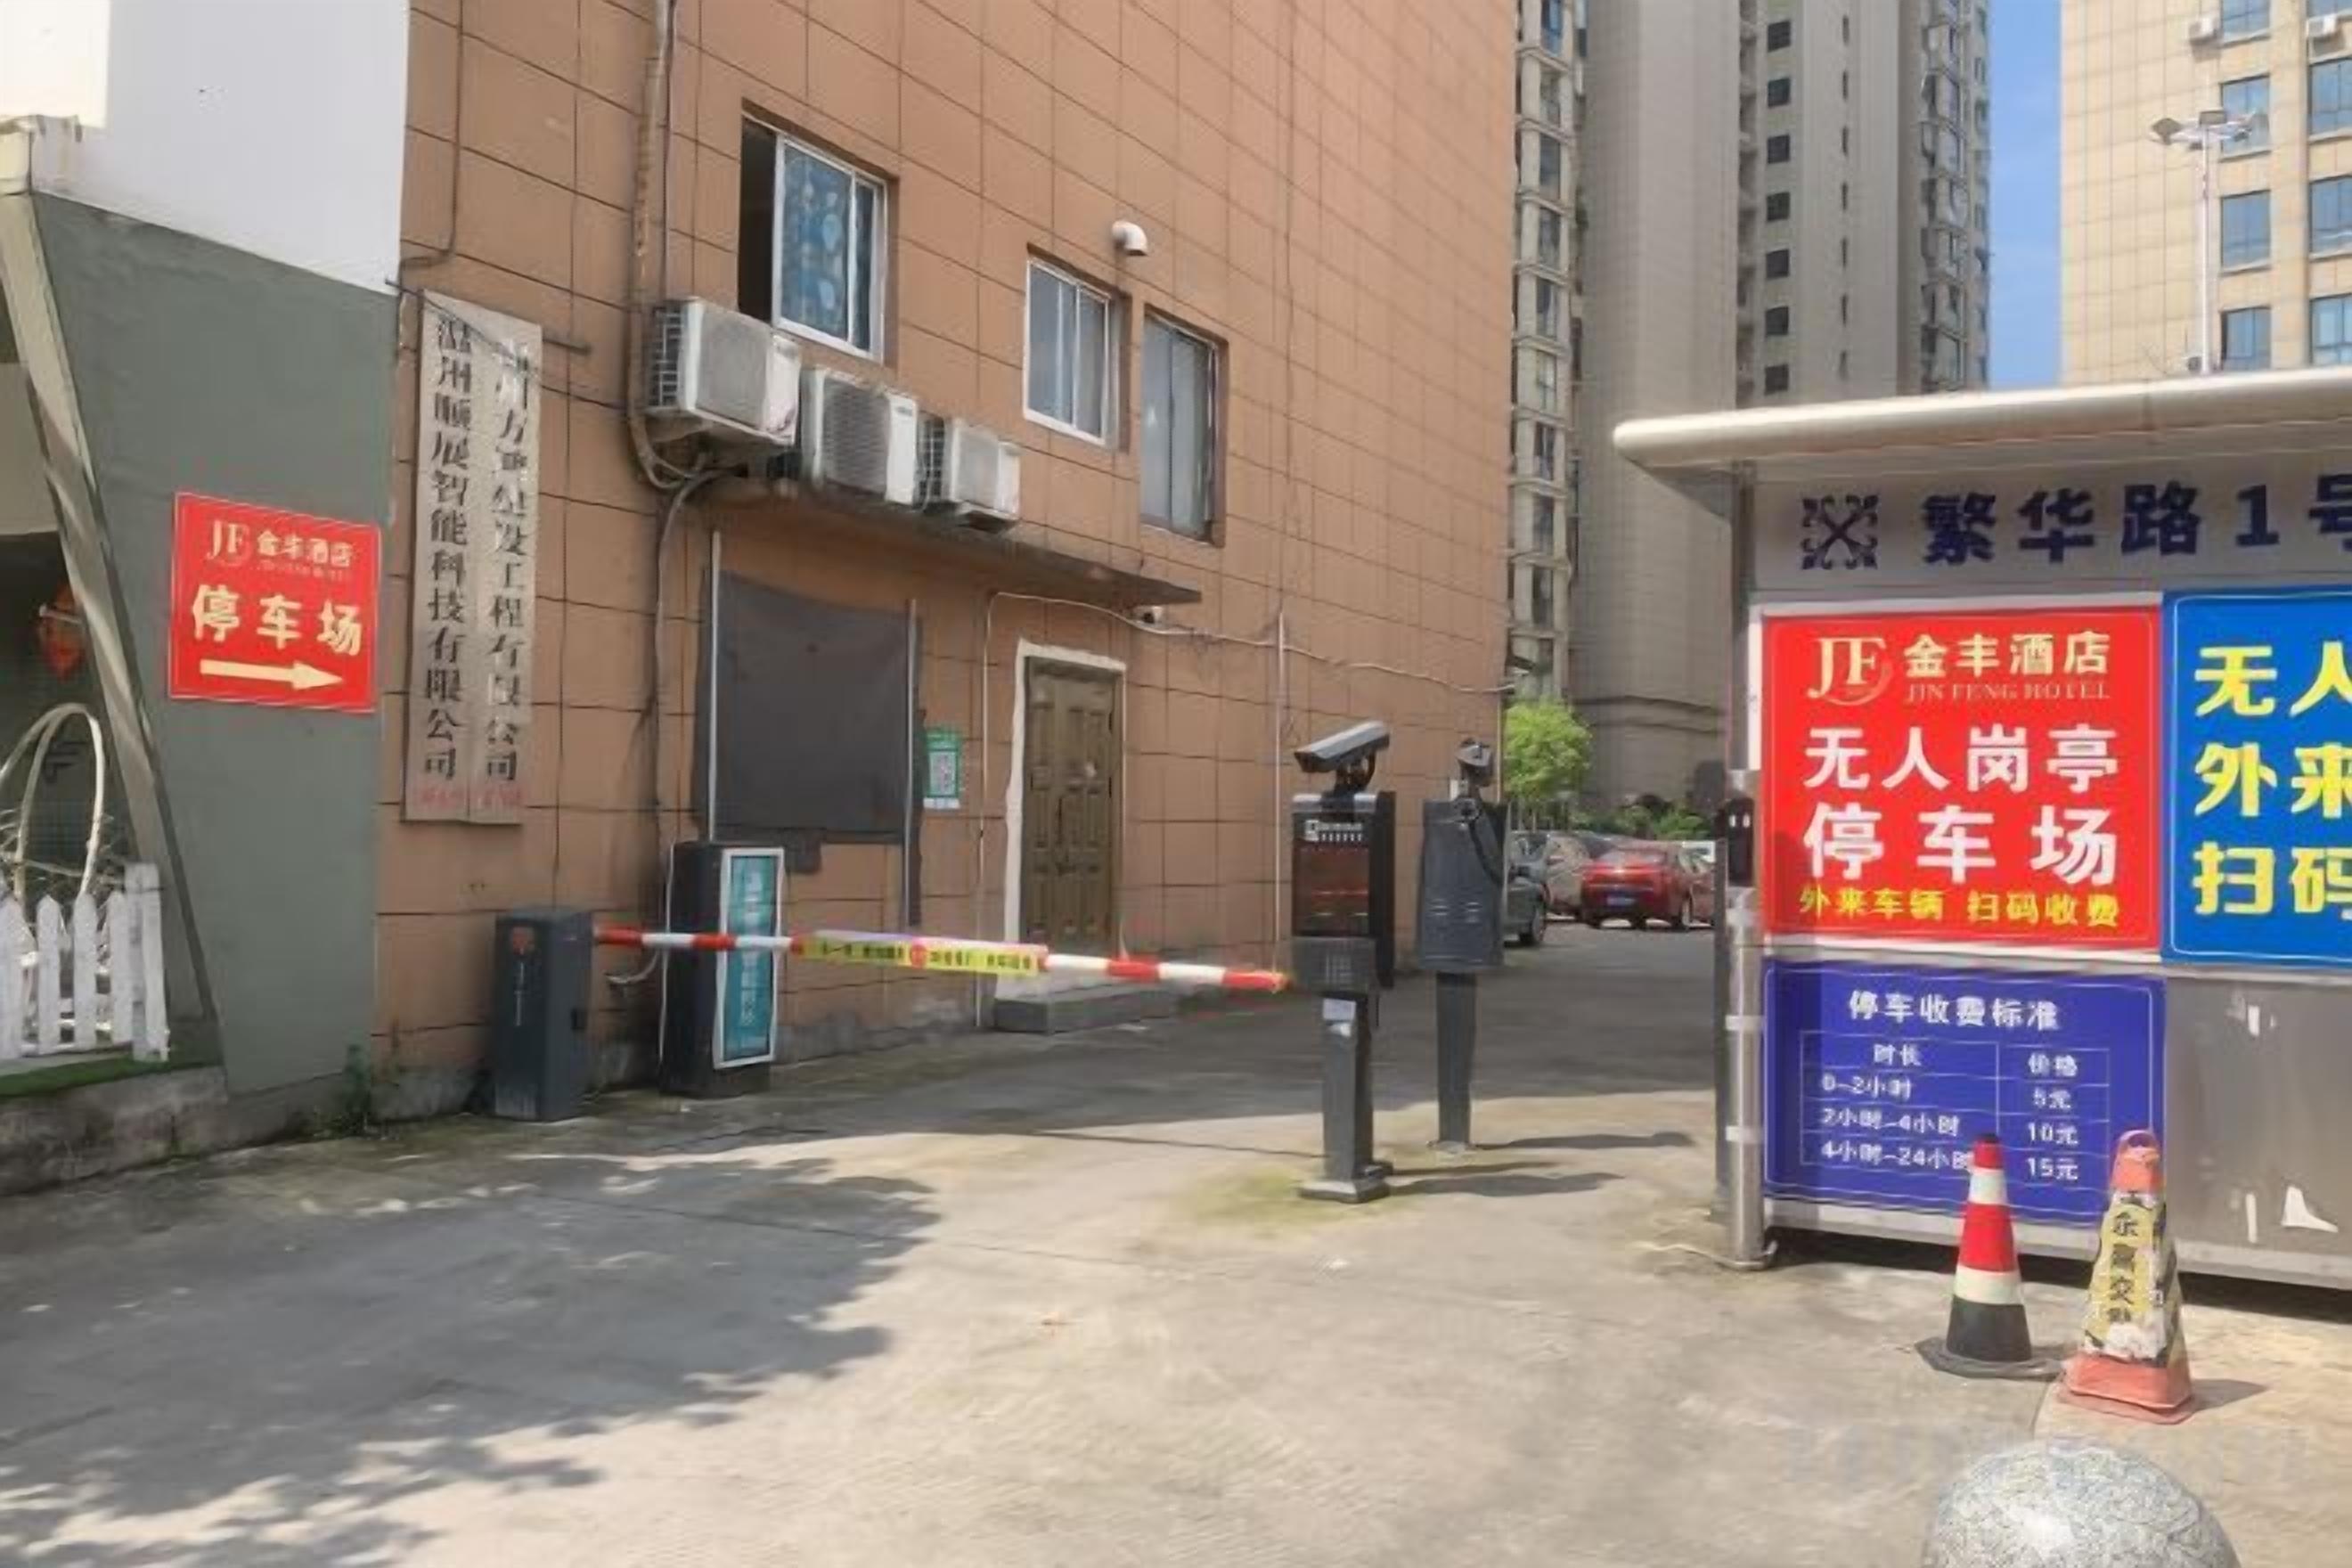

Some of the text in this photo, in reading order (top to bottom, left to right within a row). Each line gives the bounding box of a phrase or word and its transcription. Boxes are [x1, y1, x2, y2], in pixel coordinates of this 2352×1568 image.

[1921, 474, 2352, 564] 繁华路1号
[192, 584, 362, 656] 停车场
[1903, 630, 2111, 677] 金丰酒店
[1907, 682, 1944, 702] JIN
[2194, 641, 2352, 716] 无人
[1803, 723, 2119, 793] 无人岗亭
[2194, 742, 2352, 818] 外来
[1803, 803, 2119, 885] 停车场
[2193, 841, 2352, 920] 扫码
[1799, 885, 2120, 927] 外来车辆 扫码收费
[1849, 989, 2061, 1032] 停车收费标准
[1873, 1043, 1923, 1067] 时长
[2033, 1088, 2072, 1110] 5元
[2028, 1121, 2079, 1146] 10元
[2028, 1157, 2078, 1180] 15元
